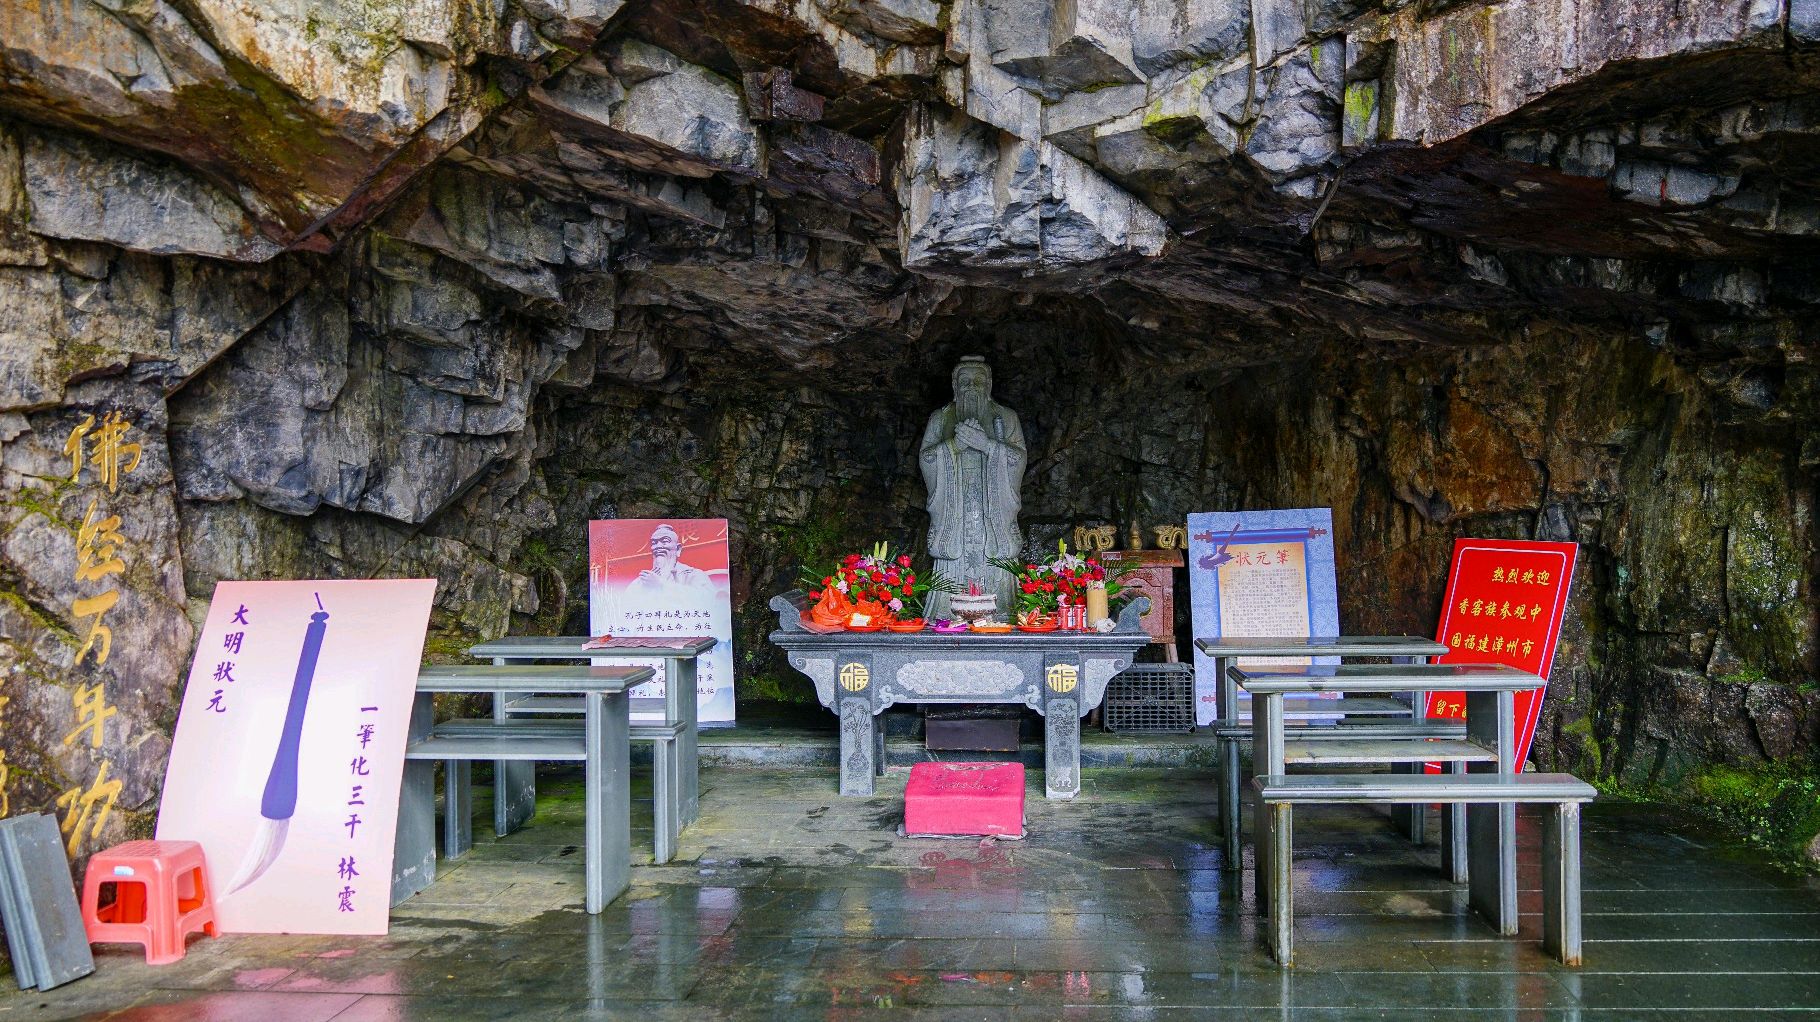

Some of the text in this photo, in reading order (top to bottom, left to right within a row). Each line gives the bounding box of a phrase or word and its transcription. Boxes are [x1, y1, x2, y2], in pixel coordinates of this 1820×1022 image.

[1491, 566, 1550, 586] 热烈欢迎
[1451, 632, 1535, 659] 国福建漳州市
[337, 705, 379, 913] 一筆化三千 林震
